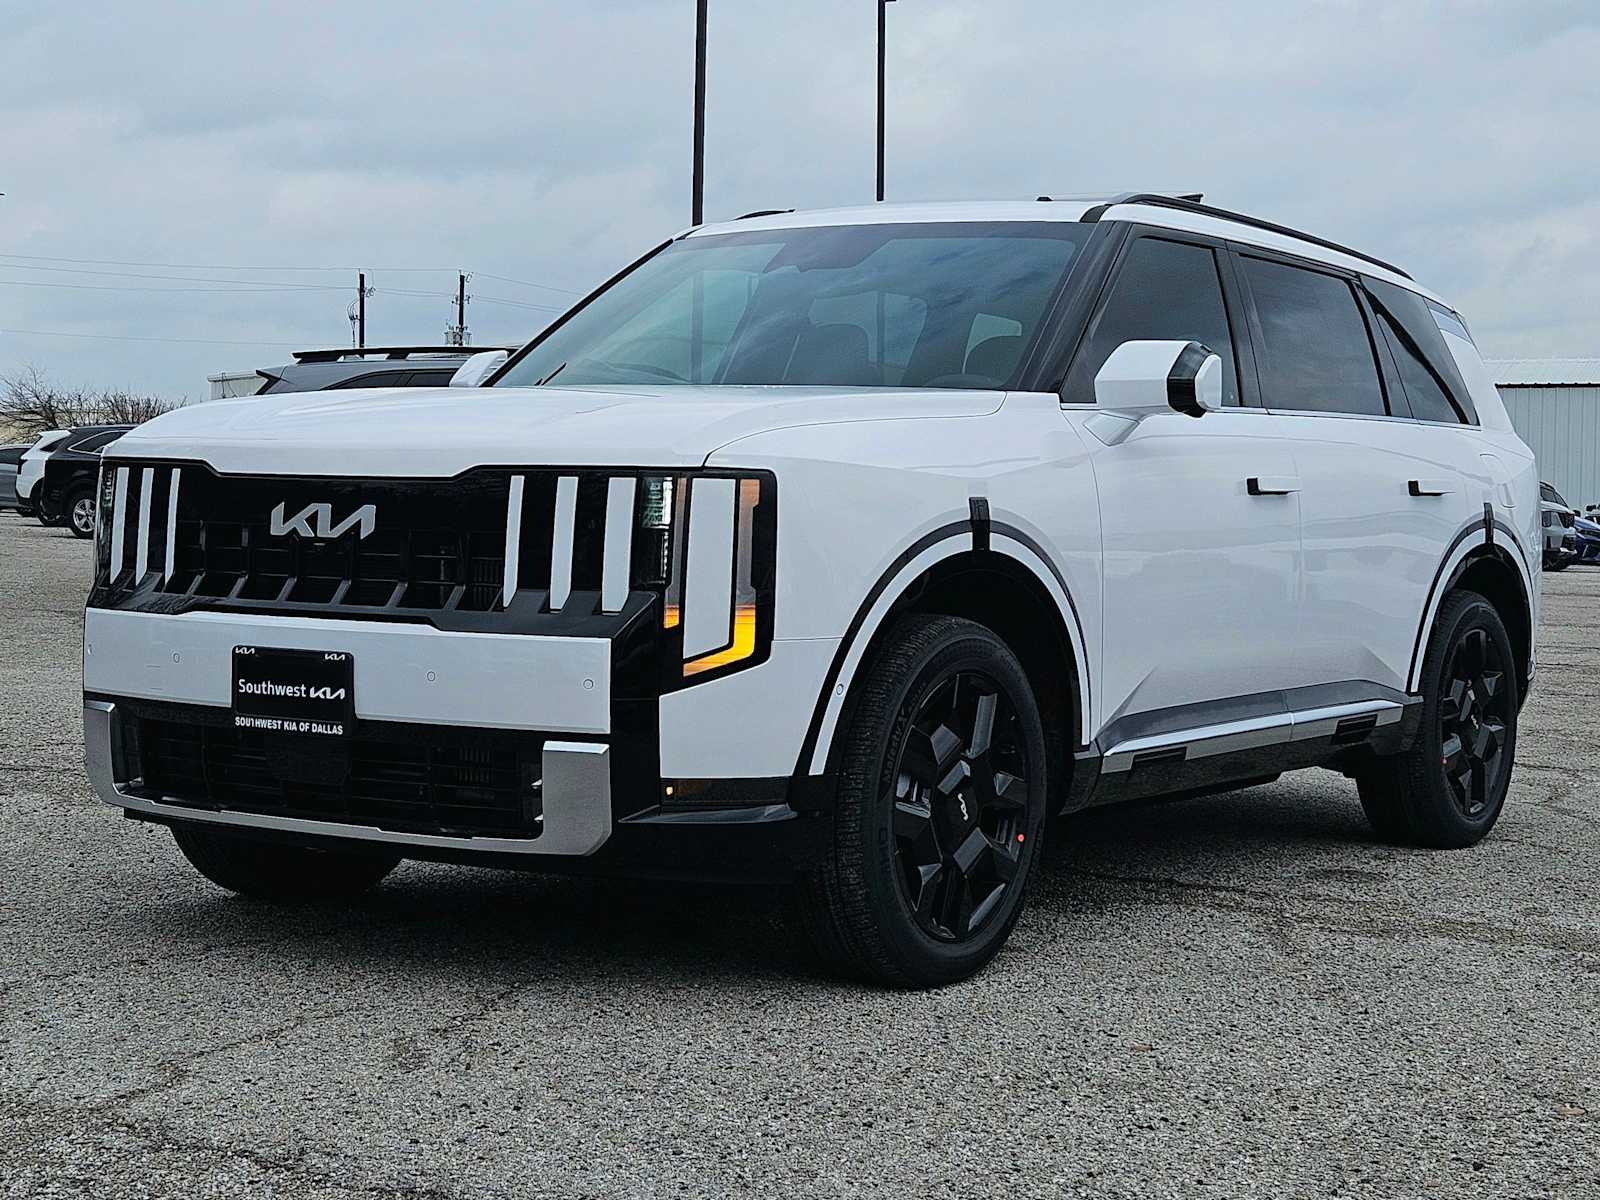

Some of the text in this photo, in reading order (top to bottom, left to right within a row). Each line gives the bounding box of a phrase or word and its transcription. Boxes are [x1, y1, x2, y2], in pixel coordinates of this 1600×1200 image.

[270, 501, 377, 540] KIA
[235, 647, 255, 655] KIA
[325, 653, 345, 661] KIA
[238, 679, 345, 699] Southwest KIA
[235, 716, 343, 735] SOUTHWEST KIA OF DALLAS
